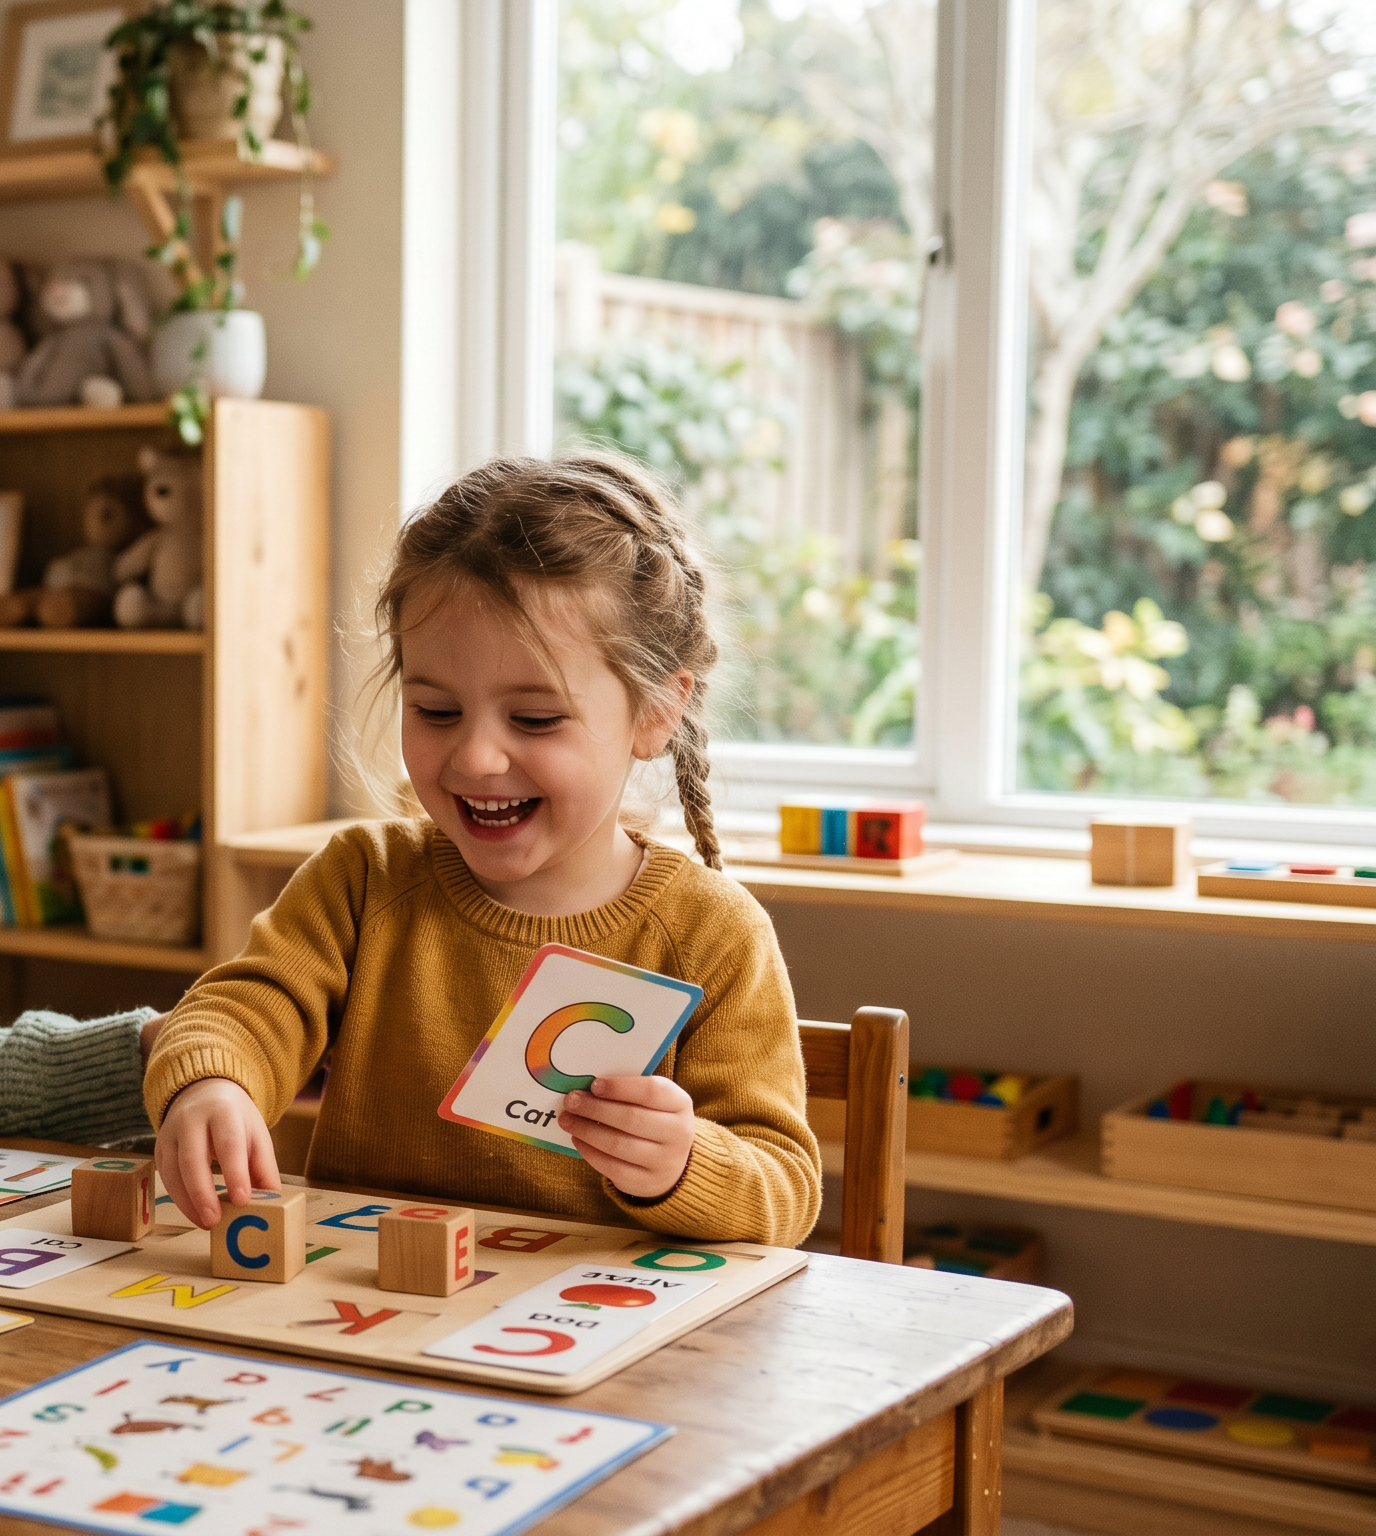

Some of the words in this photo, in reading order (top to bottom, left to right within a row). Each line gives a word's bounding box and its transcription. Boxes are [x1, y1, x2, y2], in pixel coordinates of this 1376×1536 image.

[525, 1001, 635, 1095] C
[505, 1099, 557, 1128] Cat
[226, 1214, 271, 1270] C
[454, 1225, 469, 1282] E
[108, 1273, 240, 1309] M
[472, 1326, 577, 1357] C
